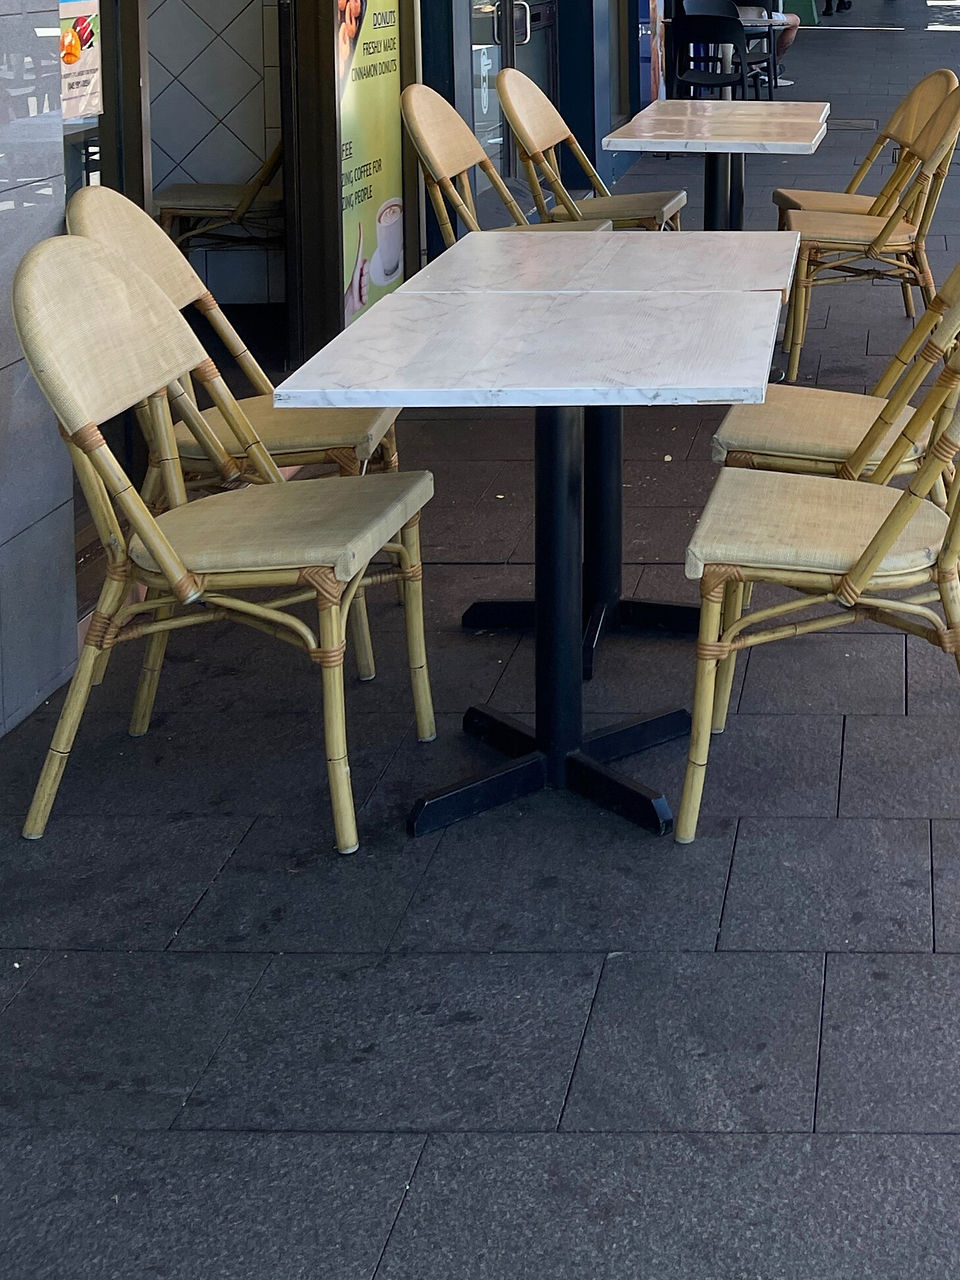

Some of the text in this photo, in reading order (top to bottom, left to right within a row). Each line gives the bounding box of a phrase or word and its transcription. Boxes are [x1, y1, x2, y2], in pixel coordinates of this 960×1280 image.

[373, 10, 396, 26] DONUTS
[363, 37, 397, 56] FRESHLY MADE
[352, 59, 397, 82] CINNAMON DONUTS
[342, 141, 353, 158] FEE
[354, 163, 371, 183] COFFEE
[372, 158, 382, 174] FOR
[355, 184, 373, 204] PEOPLE
